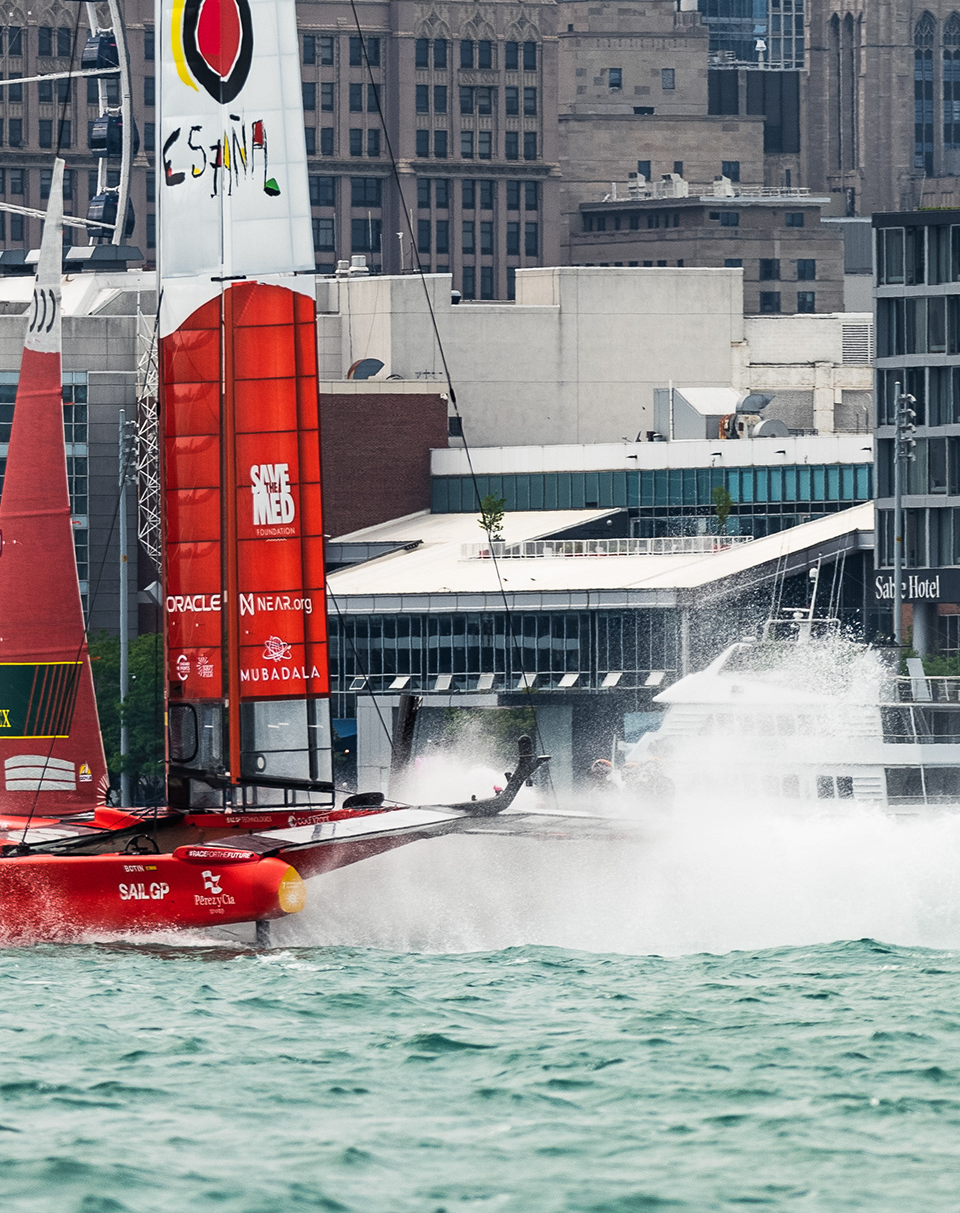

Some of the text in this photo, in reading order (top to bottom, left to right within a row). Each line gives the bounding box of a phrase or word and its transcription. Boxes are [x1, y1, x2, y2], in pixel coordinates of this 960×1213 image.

[250, 463, 291, 494] SAVE
[253, 492, 295, 525] MED
[875, 575, 940, 599] Sabe Hotel
[167, 595, 221, 612] ORACLE
[257, 596, 312, 614] NEAR.org
[241, 666, 321, 681] MUBADALA
